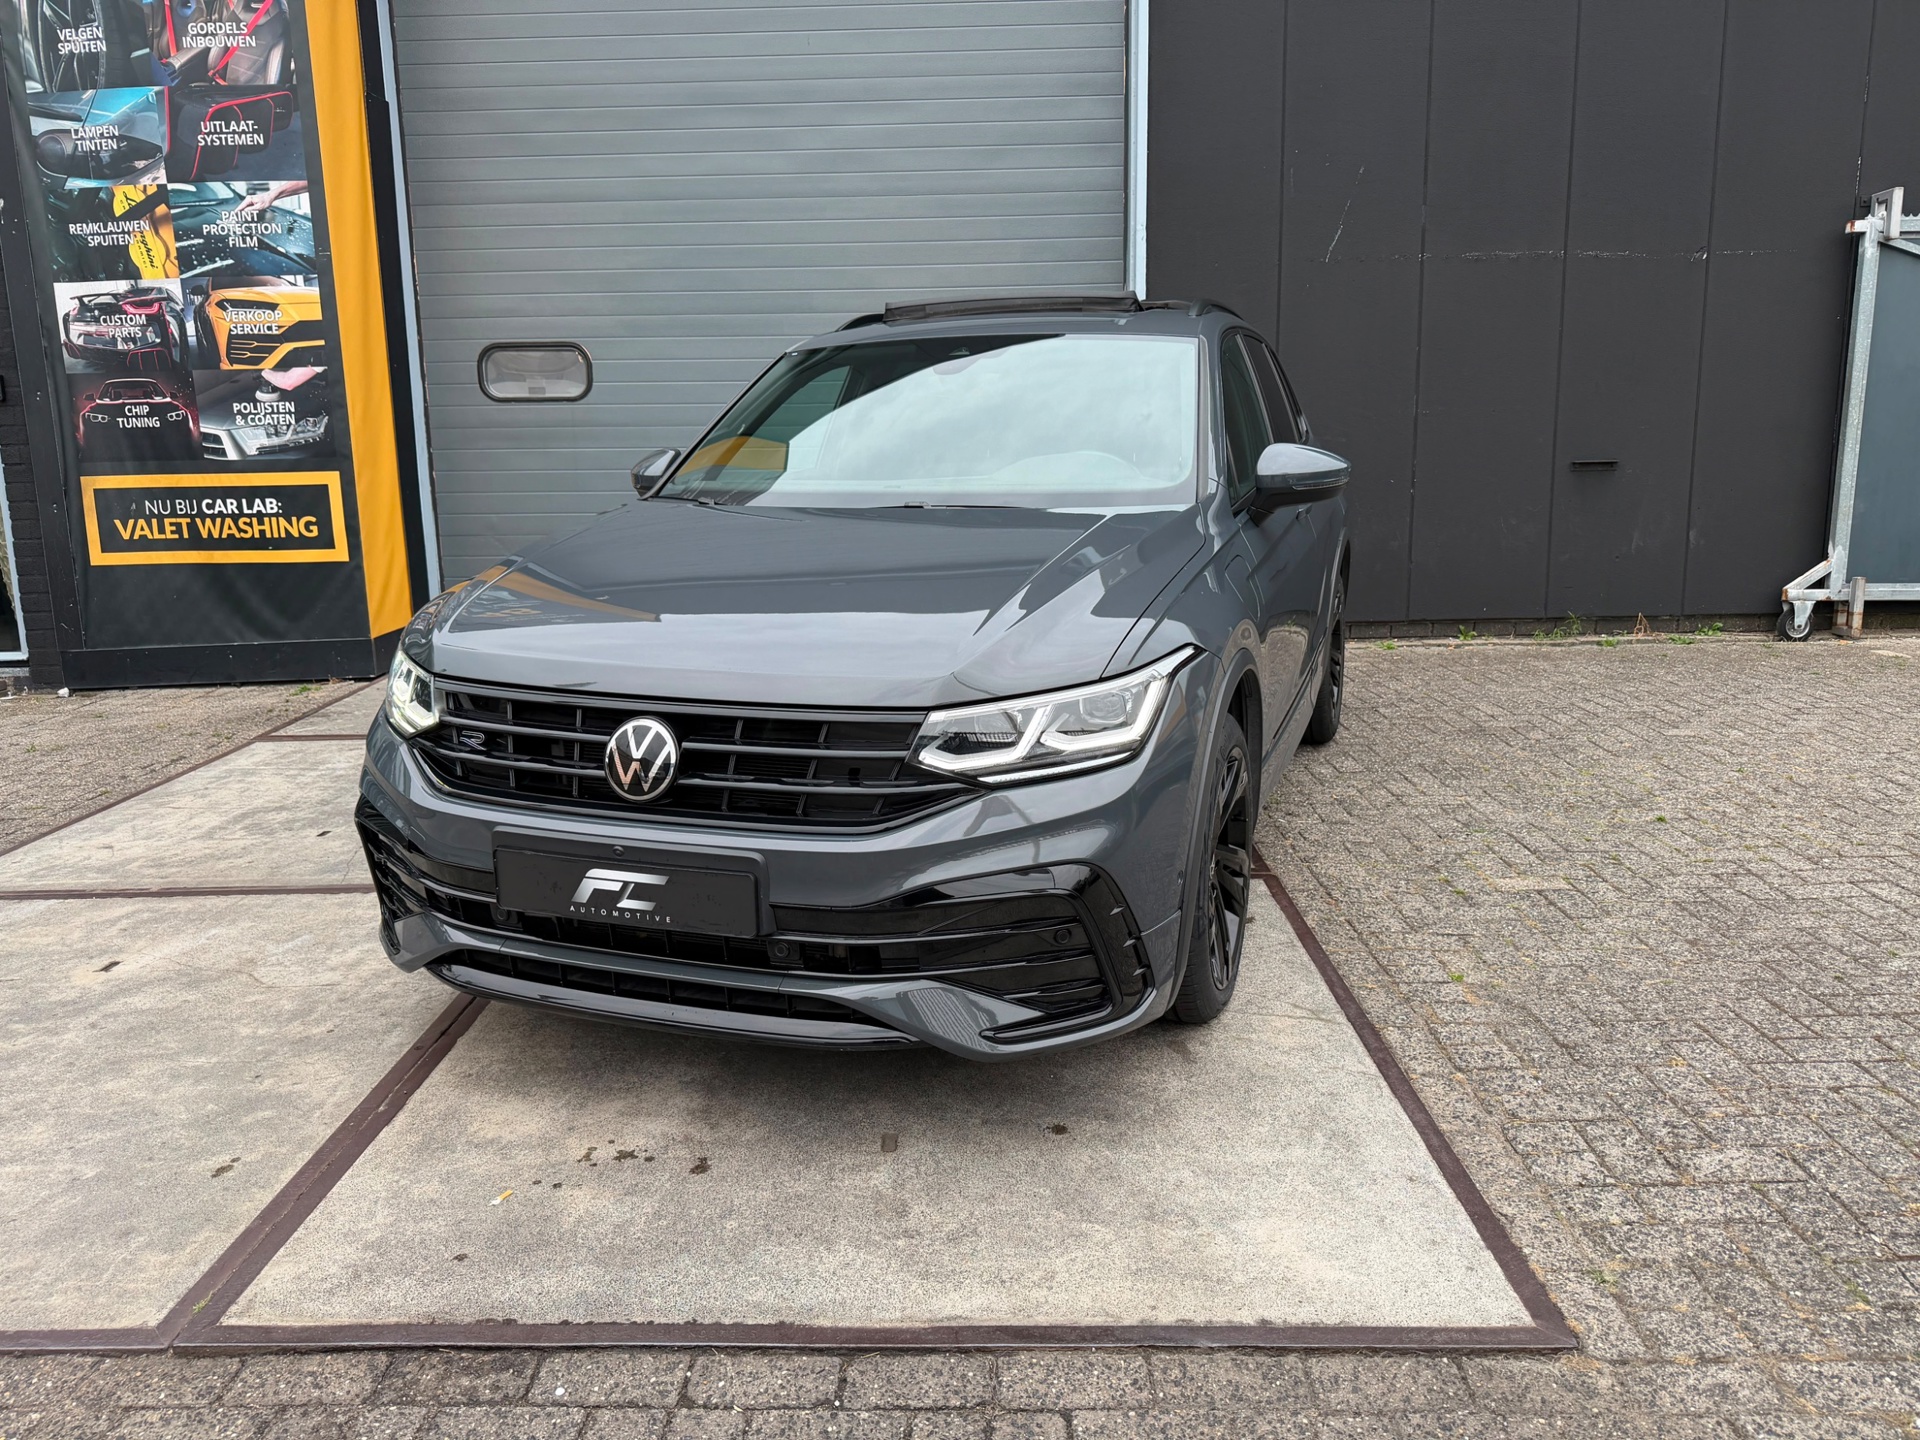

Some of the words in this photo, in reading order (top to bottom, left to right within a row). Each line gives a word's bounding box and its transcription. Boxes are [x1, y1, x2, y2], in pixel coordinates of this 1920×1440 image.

[57, 27, 103, 41] VELGEN
[187, 22, 248, 35] GORDELS
[58, 40, 107, 54] SPUITEN
[182, 35, 257, 48] INBOUWEN
[71, 125, 119, 139] LAMPEN
[201, 120, 259, 133] UITLAAT-
[75, 139, 118, 152] TINTEN
[197, 134, 264, 147] SYSTEMEN
[221, 210, 259, 223] PAINT
[68, 220, 150, 235] REMKLAUWEN
[202, 223, 282, 236] PROTECTION
[87, 234, 135, 247] SPUITEN
[228, 236, 259, 248] FILM
[100, 314, 147, 326] CUSTOM
[224, 310, 283, 322] VERKOOP
[108, 327, 142, 338] PARTS
[230, 323, 279, 335] SERVICE
[124, 405, 150, 416] CHIP
[232, 402, 296, 414] POLIJSTEN
[116, 417, 161, 428] TUNING
[235, 415, 246, 427] &
[247, 413, 296, 426] COATEN
[144, 500, 172, 515] NU
[176, 500, 198, 515] BIJ
[201, 499, 242, 514] CAR
[243, 499, 283, 514] LAB:
[114, 518, 191, 540] VALET
[194, 516, 319, 539] WASHING
[569, 905, 672, 923] AUTOMOTIVE
